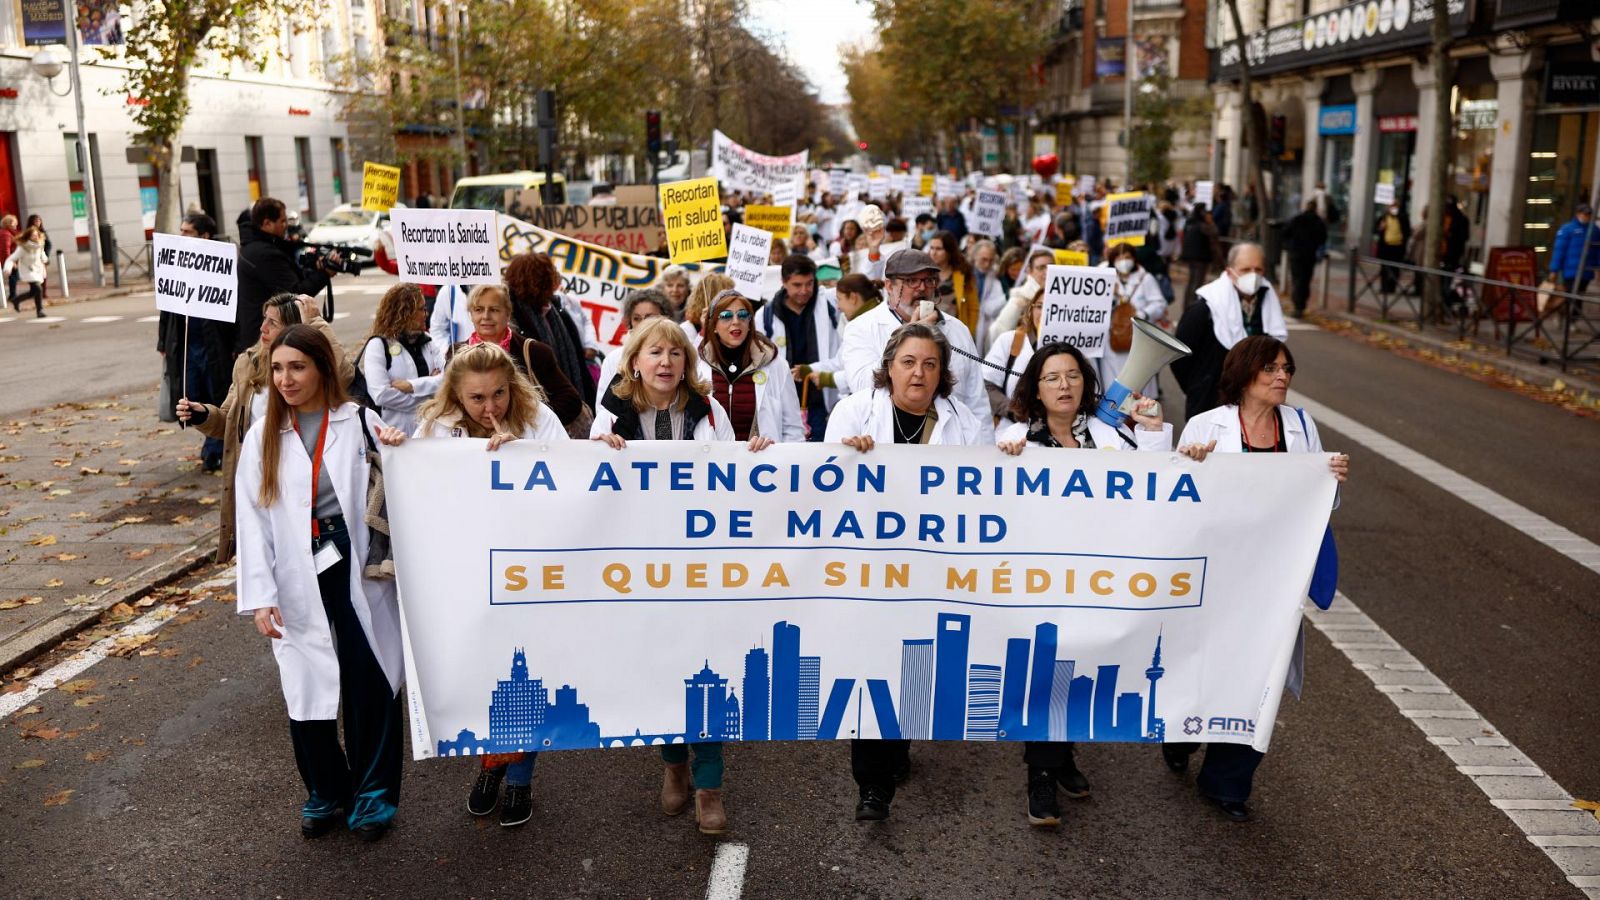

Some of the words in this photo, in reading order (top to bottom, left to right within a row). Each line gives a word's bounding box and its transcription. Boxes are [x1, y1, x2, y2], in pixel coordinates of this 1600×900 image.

[364, 165, 398, 179] ¡Recortan
[364, 181, 374, 190] mi
[376, 182, 397, 194] salud
[663, 184, 715, 210] ¡Recortan
[364, 195, 369, 206] y
[370, 194, 380, 204] mi
[592, 205, 657, 231] PUBLICA
[667, 210, 682, 230] mi
[685, 205, 718, 227] salud
[401, 221, 447, 243] Recortaron
[448, 222, 455, 243] la
[457, 222, 490, 244] Sanidad.
[672, 240, 679, 257] y
[681, 233, 694, 251] mi
[696, 228, 722, 248] vida!
[735, 230, 740, 240] A
[741, 233, 748, 243] su
[157, 248, 176, 268] ¡ME
[177, 250, 233, 275] RECORTAN
[405, 255, 417, 275] Sus
[418, 261, 447, 276] muertos
[449, 256, 460, 277] les
[461, 255, 492, 278] botarán.
[732, 247, 741, 264] hoy
[743, 250, 765, 265] llaman
[157, 277, 186, 298] SALUD
[197, 284, 232, 306] VIDA!
[1049, 276, 1111, 297] AYUSO:
[1044, 303, 1107, 327] ¡Privatizar
[1063, 332, 1105, 349] robar!
[490, 460, 557, 492] LA
[589, 455, 886, 493] ATENCIÓN
[920, 464, 1201, 503] PRIMARIA
[685, 509, 753, 539] DE
[787, 509, 1008, 544] MADRID
[504, 565, 566, 592] SE
[602, 562, 790, 594] QUEDA
[825, 561, 910, 588] SIN
[945, 561, 1192, 598] MÉDICOS
